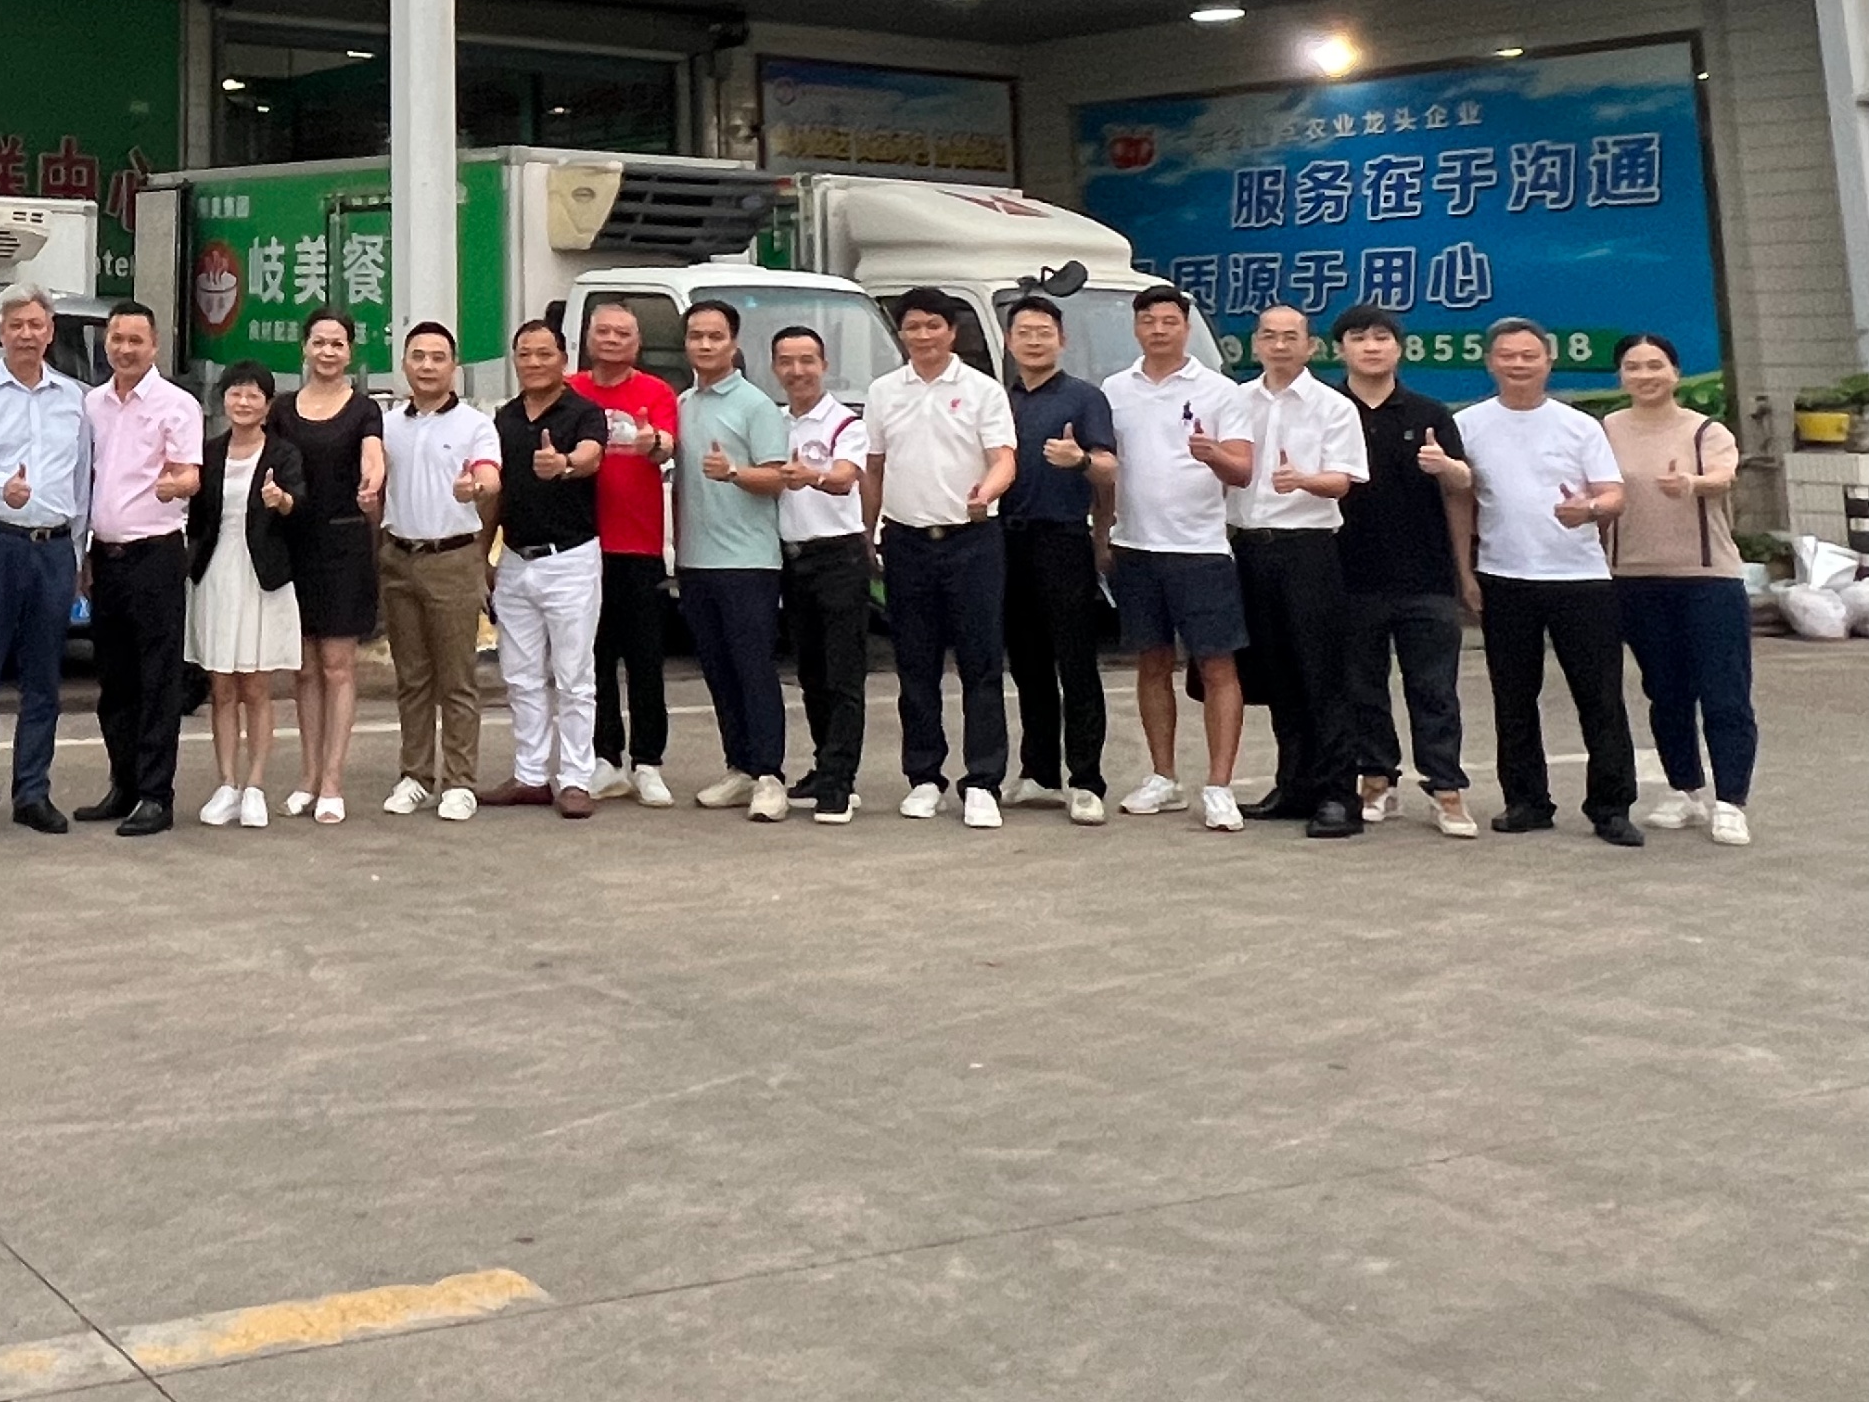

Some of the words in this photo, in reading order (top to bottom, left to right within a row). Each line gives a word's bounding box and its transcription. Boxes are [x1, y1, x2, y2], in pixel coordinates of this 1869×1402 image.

[1232, 132, 1661, 228] 服务在于沟通
[1133, 241, 1493, 317] 质源于用心
